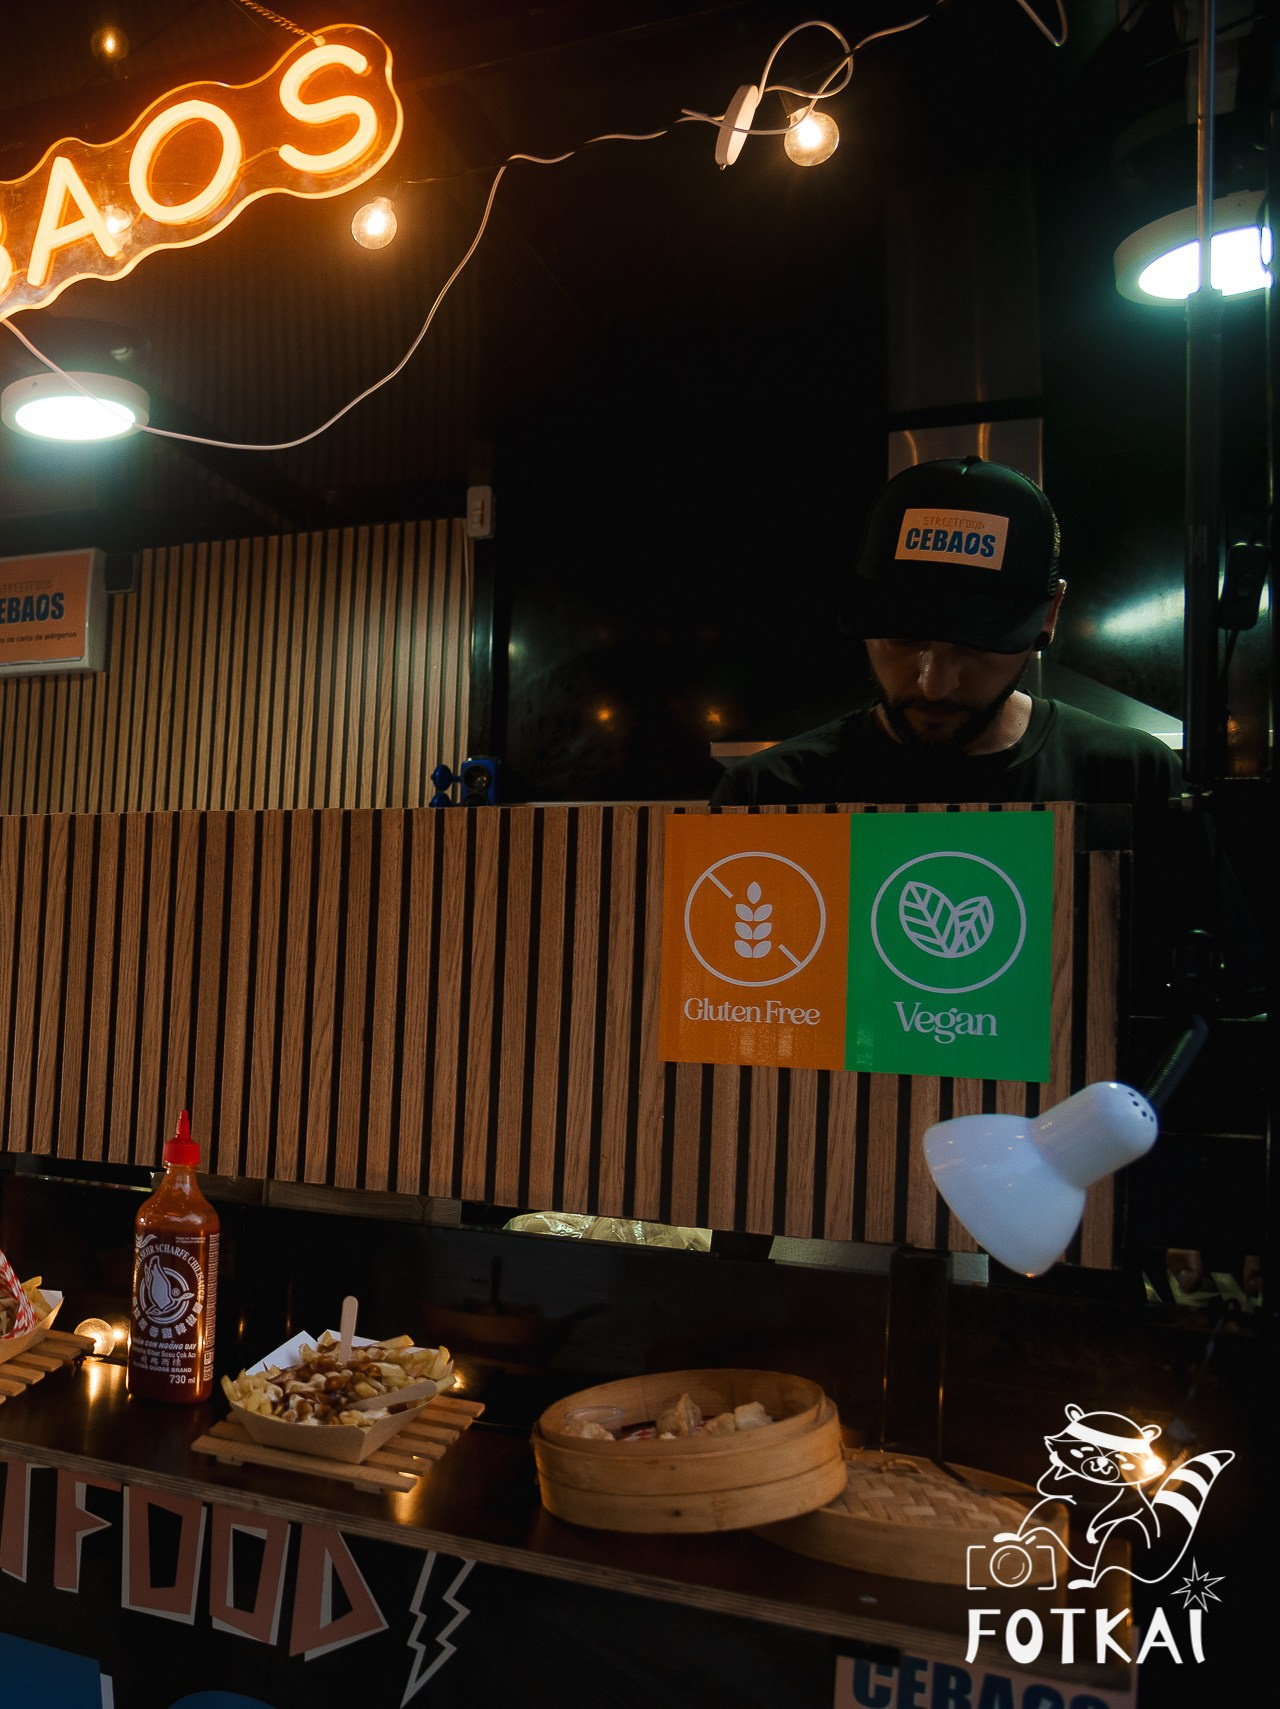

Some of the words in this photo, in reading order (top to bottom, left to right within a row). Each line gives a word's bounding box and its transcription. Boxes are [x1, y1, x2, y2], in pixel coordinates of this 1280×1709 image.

[904, 527, 997, 558] CEBAOS
[683, 997, 762, 1024] Gluten
[765, 1000, 821, 1026] Free
[893, 1001, 998, 1045] Vegan
[154, 1243, 190, 1261] SCHARFE
[169, 1374, 187, 1384] 730
[187, 1376, 196, 1384] ml
